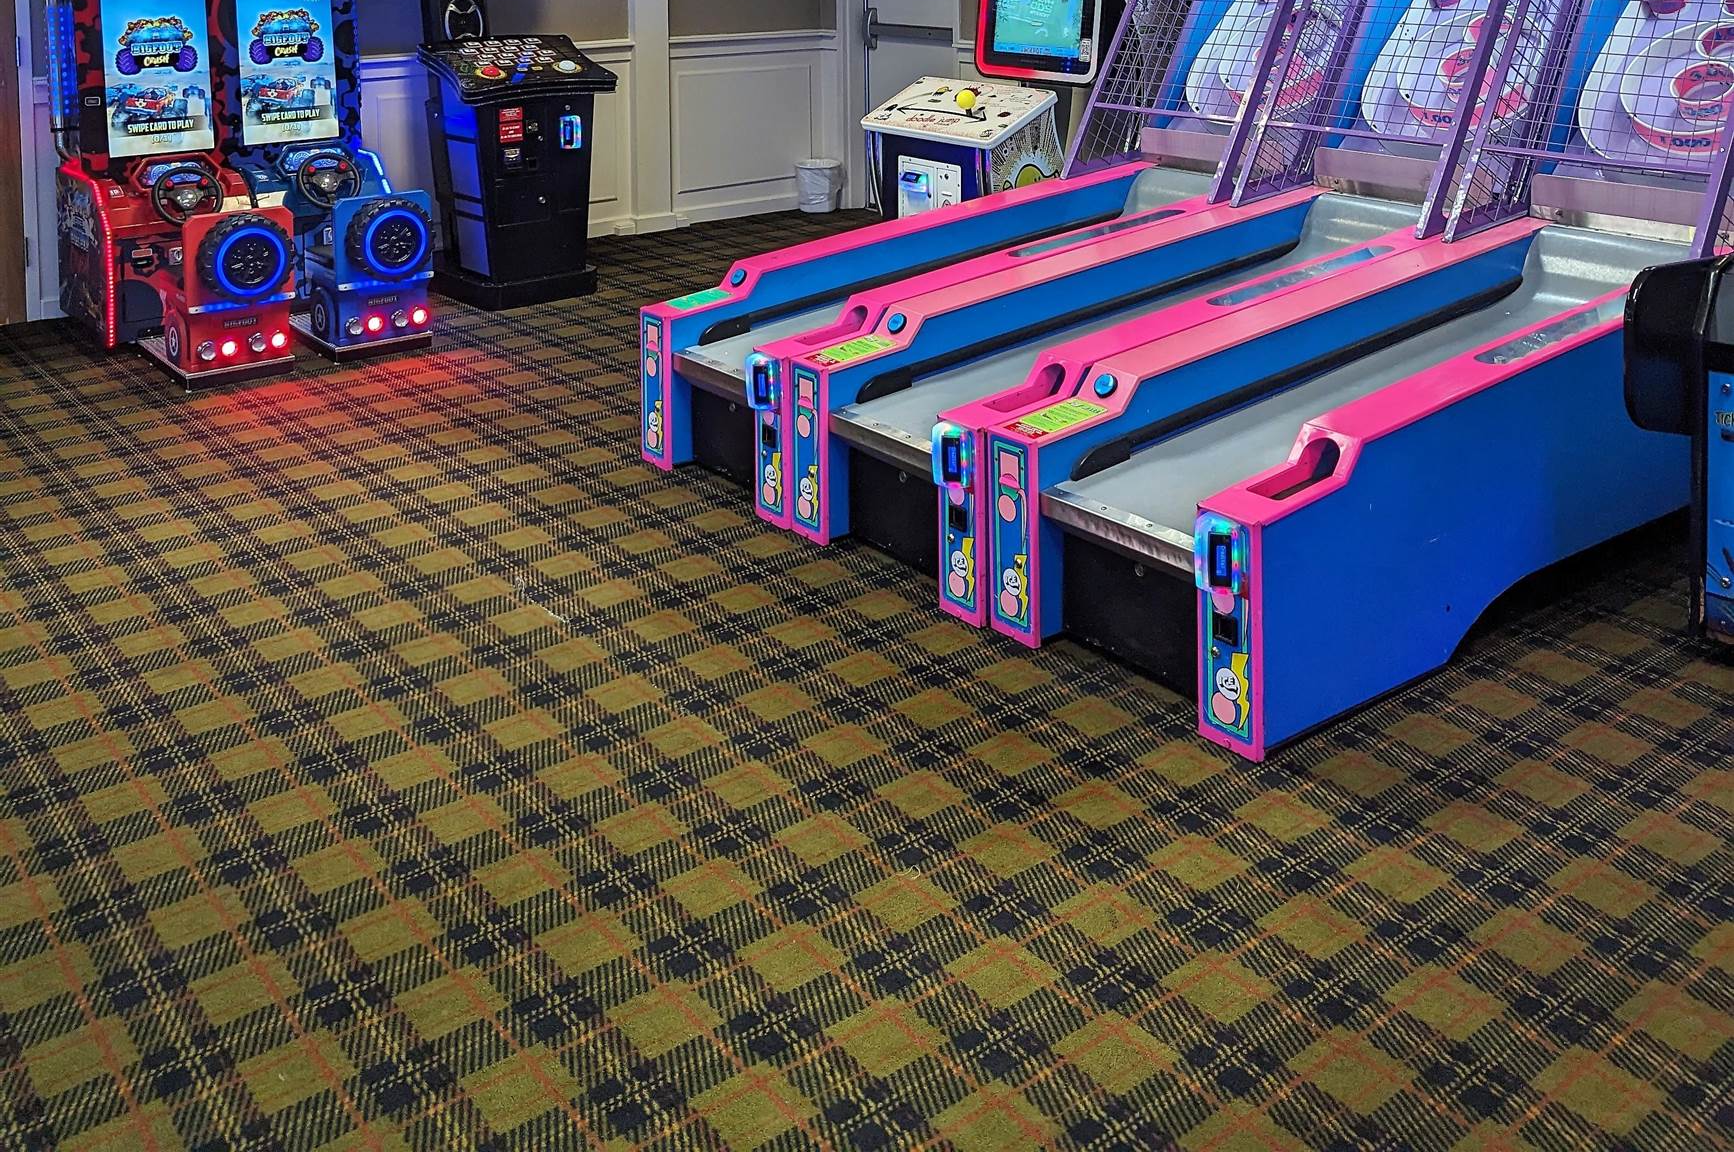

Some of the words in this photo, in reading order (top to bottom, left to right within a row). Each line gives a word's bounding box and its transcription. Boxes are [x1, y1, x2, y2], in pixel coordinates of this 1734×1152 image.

[261, 111, 280, 122] SWIPE
[281, 110, 296, 121] CARD
[296, 109, 304, 119] TO
[304, 108, 320, 118] PLAY
[127, 123, 149, 134] SWIPE
[149, 121, 168, 132] CARD
[168, 120, 177, 130] TO
[177, 118, 194, 129] PLAY
